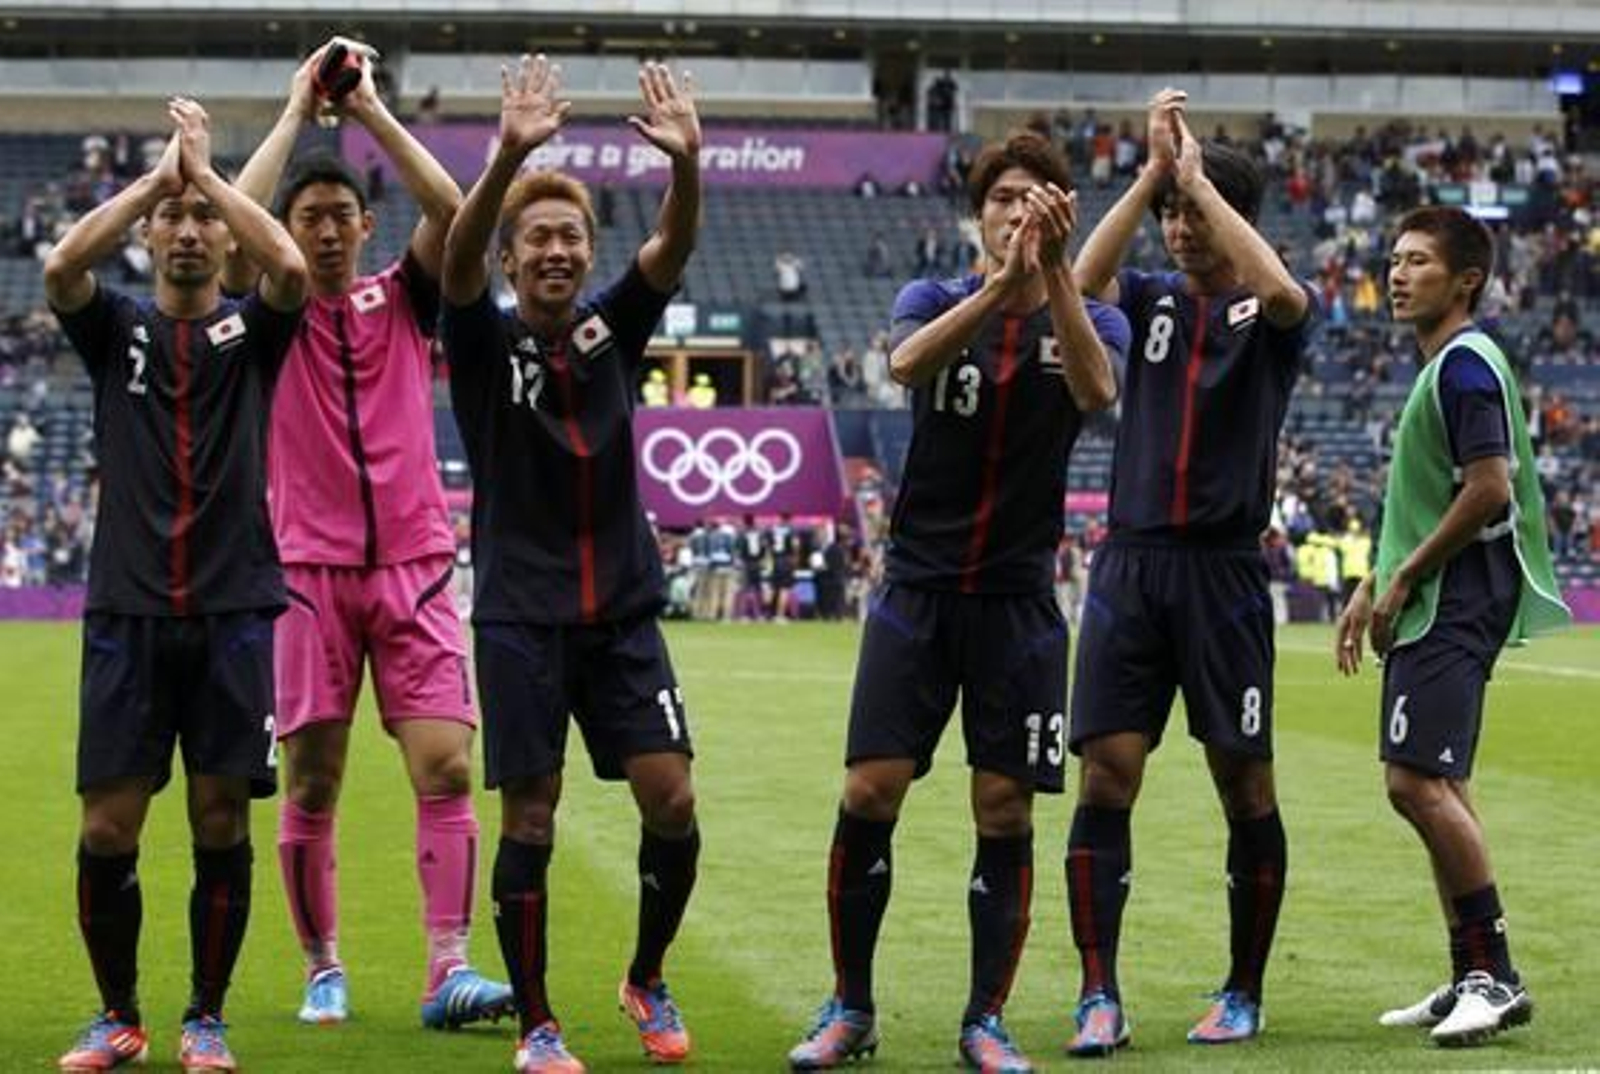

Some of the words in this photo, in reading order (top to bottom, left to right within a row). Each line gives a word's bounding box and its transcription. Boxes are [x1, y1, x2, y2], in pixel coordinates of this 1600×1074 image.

[599, 143, 622, 168] a
[1144, 315, 1174, 363] 8
[127, 345, 147, 395] 2
[509, 355, 545, 411] 17
[934, 364, 982, 417] 13
[1241, 687, 1261, 736] 8
[1389, 695, 1408, 743] 6
[1025, 712, 1063, 766] 13
